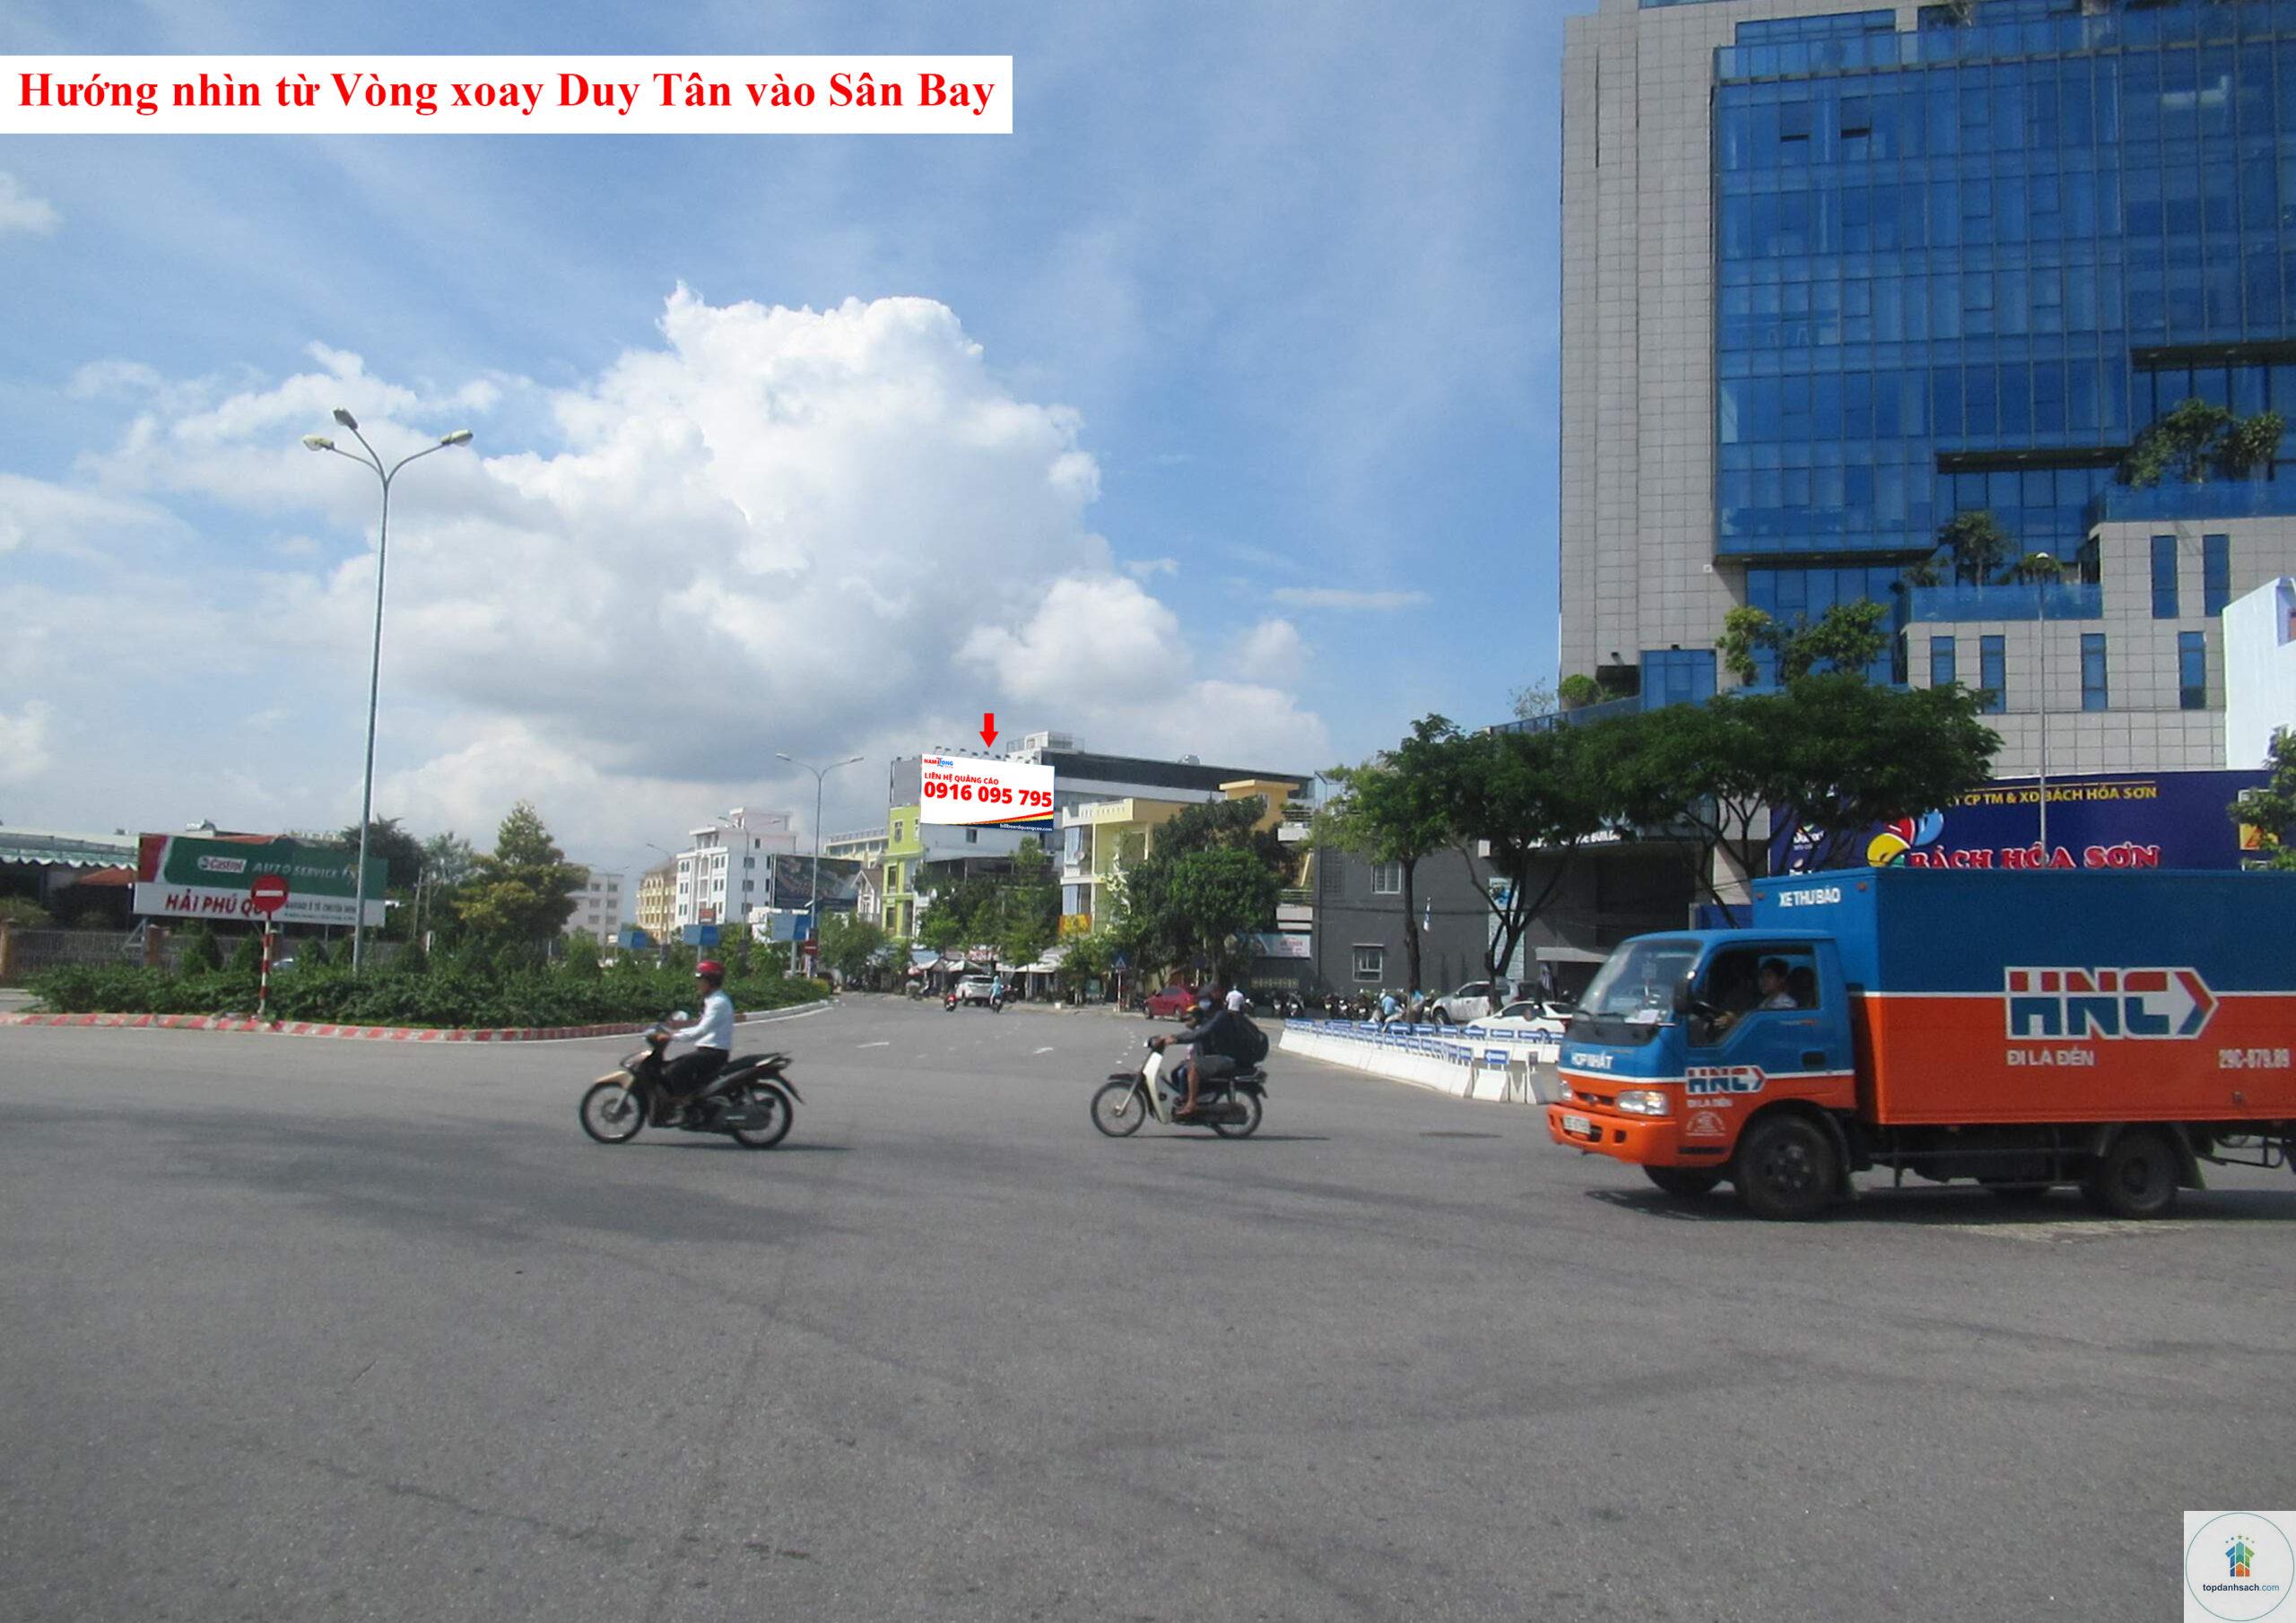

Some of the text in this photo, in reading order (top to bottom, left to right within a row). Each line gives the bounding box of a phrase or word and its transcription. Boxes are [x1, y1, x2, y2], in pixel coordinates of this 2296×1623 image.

[925, 772, 941, 780] LIÊN
[944, 774, 952, 782] HỆ
[984, 777, 999, 785] CÁO
[924, 781, 1052, 807] 0916 095 795
[1964, 794, 1981, 805] CP
[1985, 794, 2004, 804] TM
[2006, 792, 2016, 803] &
[2020, 791, 2040, 803] XD
[2083, 841, 2161, 869] SƠN
[166, 888, 198, 912] HẢI
[203, 893, 238, 914] PHÚ
[1779, 891, 1793, 907] XE
